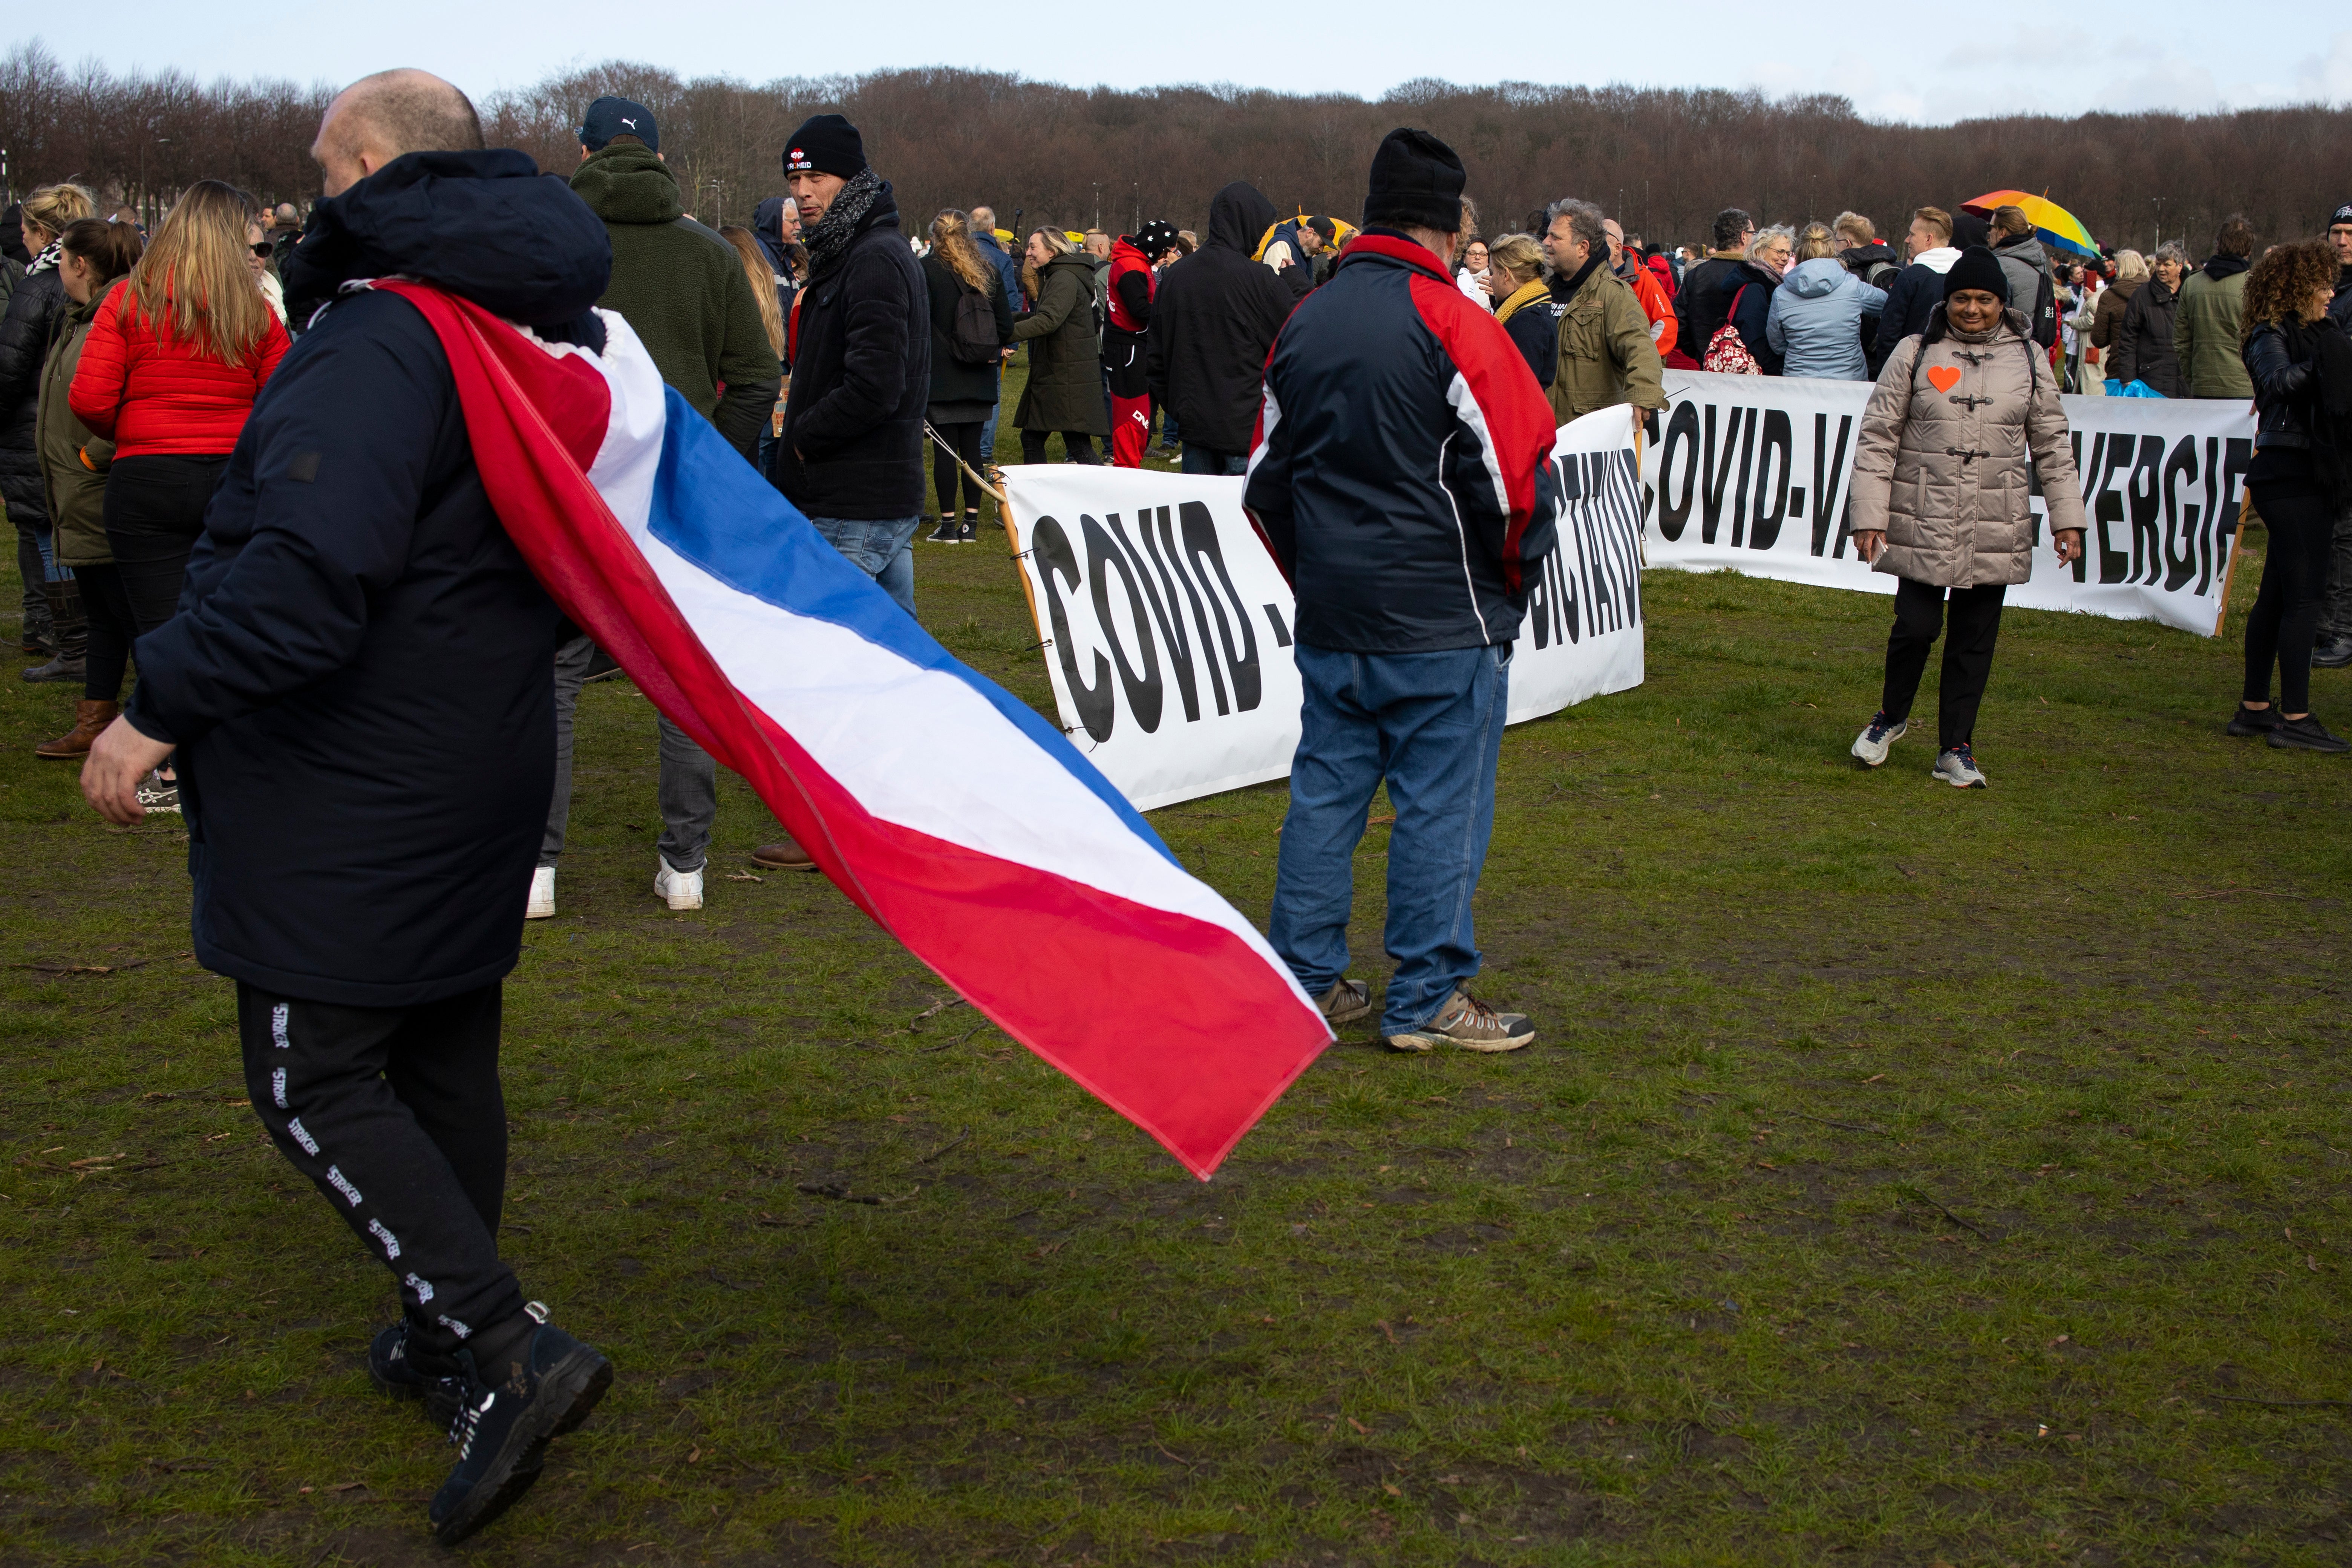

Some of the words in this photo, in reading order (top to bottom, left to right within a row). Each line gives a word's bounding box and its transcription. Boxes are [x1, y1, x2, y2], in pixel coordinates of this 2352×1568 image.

[787, 162, 812, 171] VRIJHEID
[272, 1004, 289, 1048] STRIKER
[288, 1117, 320, 1156] STRIKER
[327, 1165, 362, 1207] STRIKER
[369, 1219, 400, 1260] STRIKER
